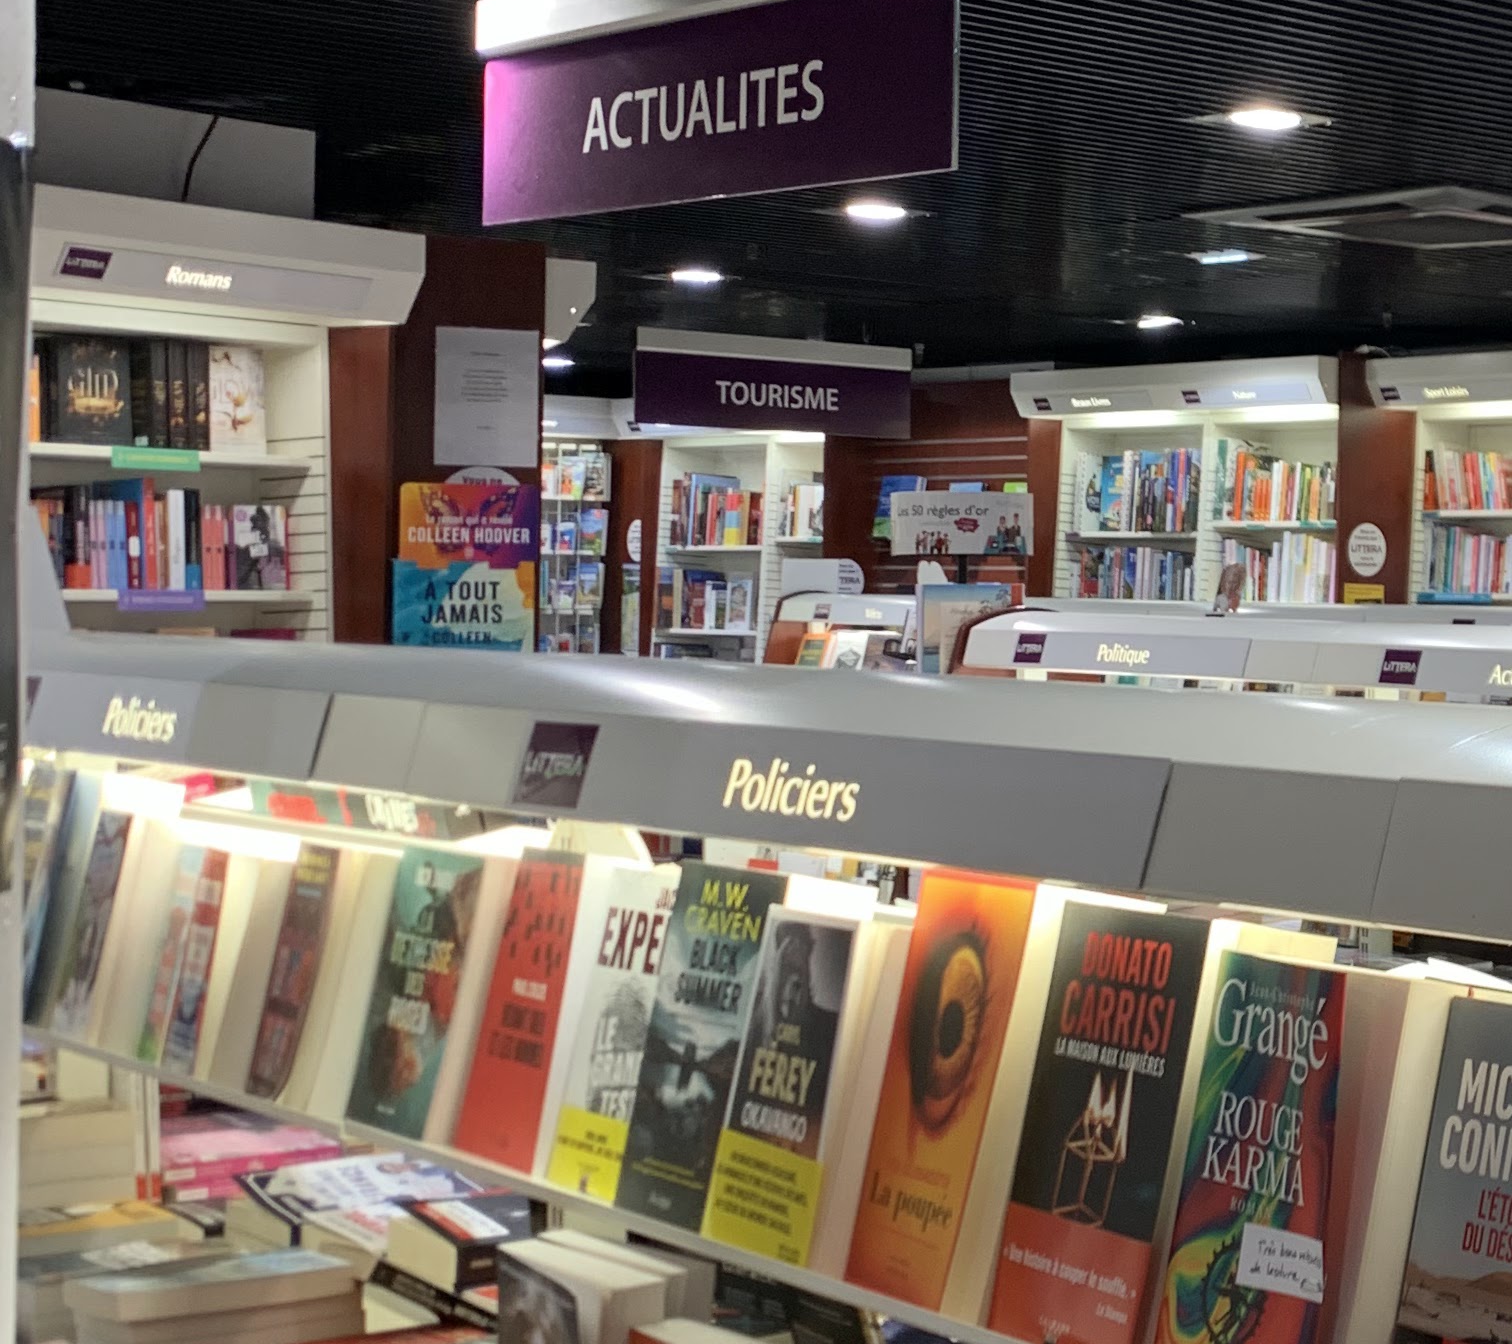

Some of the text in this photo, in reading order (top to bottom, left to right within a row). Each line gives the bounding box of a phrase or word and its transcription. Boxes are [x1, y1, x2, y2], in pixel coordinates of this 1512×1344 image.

[582, 59, 825, 154] ACTUALITES
[166, 265, 232, 290] Romans
[715, 379, 839, 412] TOURISME
[407, 526, 531, 544] COLLEEN HOOVER
[447, 581, 500, 600] TOUT
[422, 605, 503, 624] JAMAIS
[1096, 642, 1151, 667] Politique
[103, 697, 177, 744] Policiers
[722, 757, 861, 823] Policiers
[700, 878, 750, 912] M.W.
[683, 905, 762, 944] CRAVEN
[1081, 931, 1174, 985] DONATO
[1060, 978, 1177, 1054] CARRISI
[1214, 977, 1329, 1084] Grangé
[1214, 1091, 1305, 1157] ROUGE
[1202, 1135, 1306, 1207] KARMA
[1462, 1221, 1495, 1257] DU
